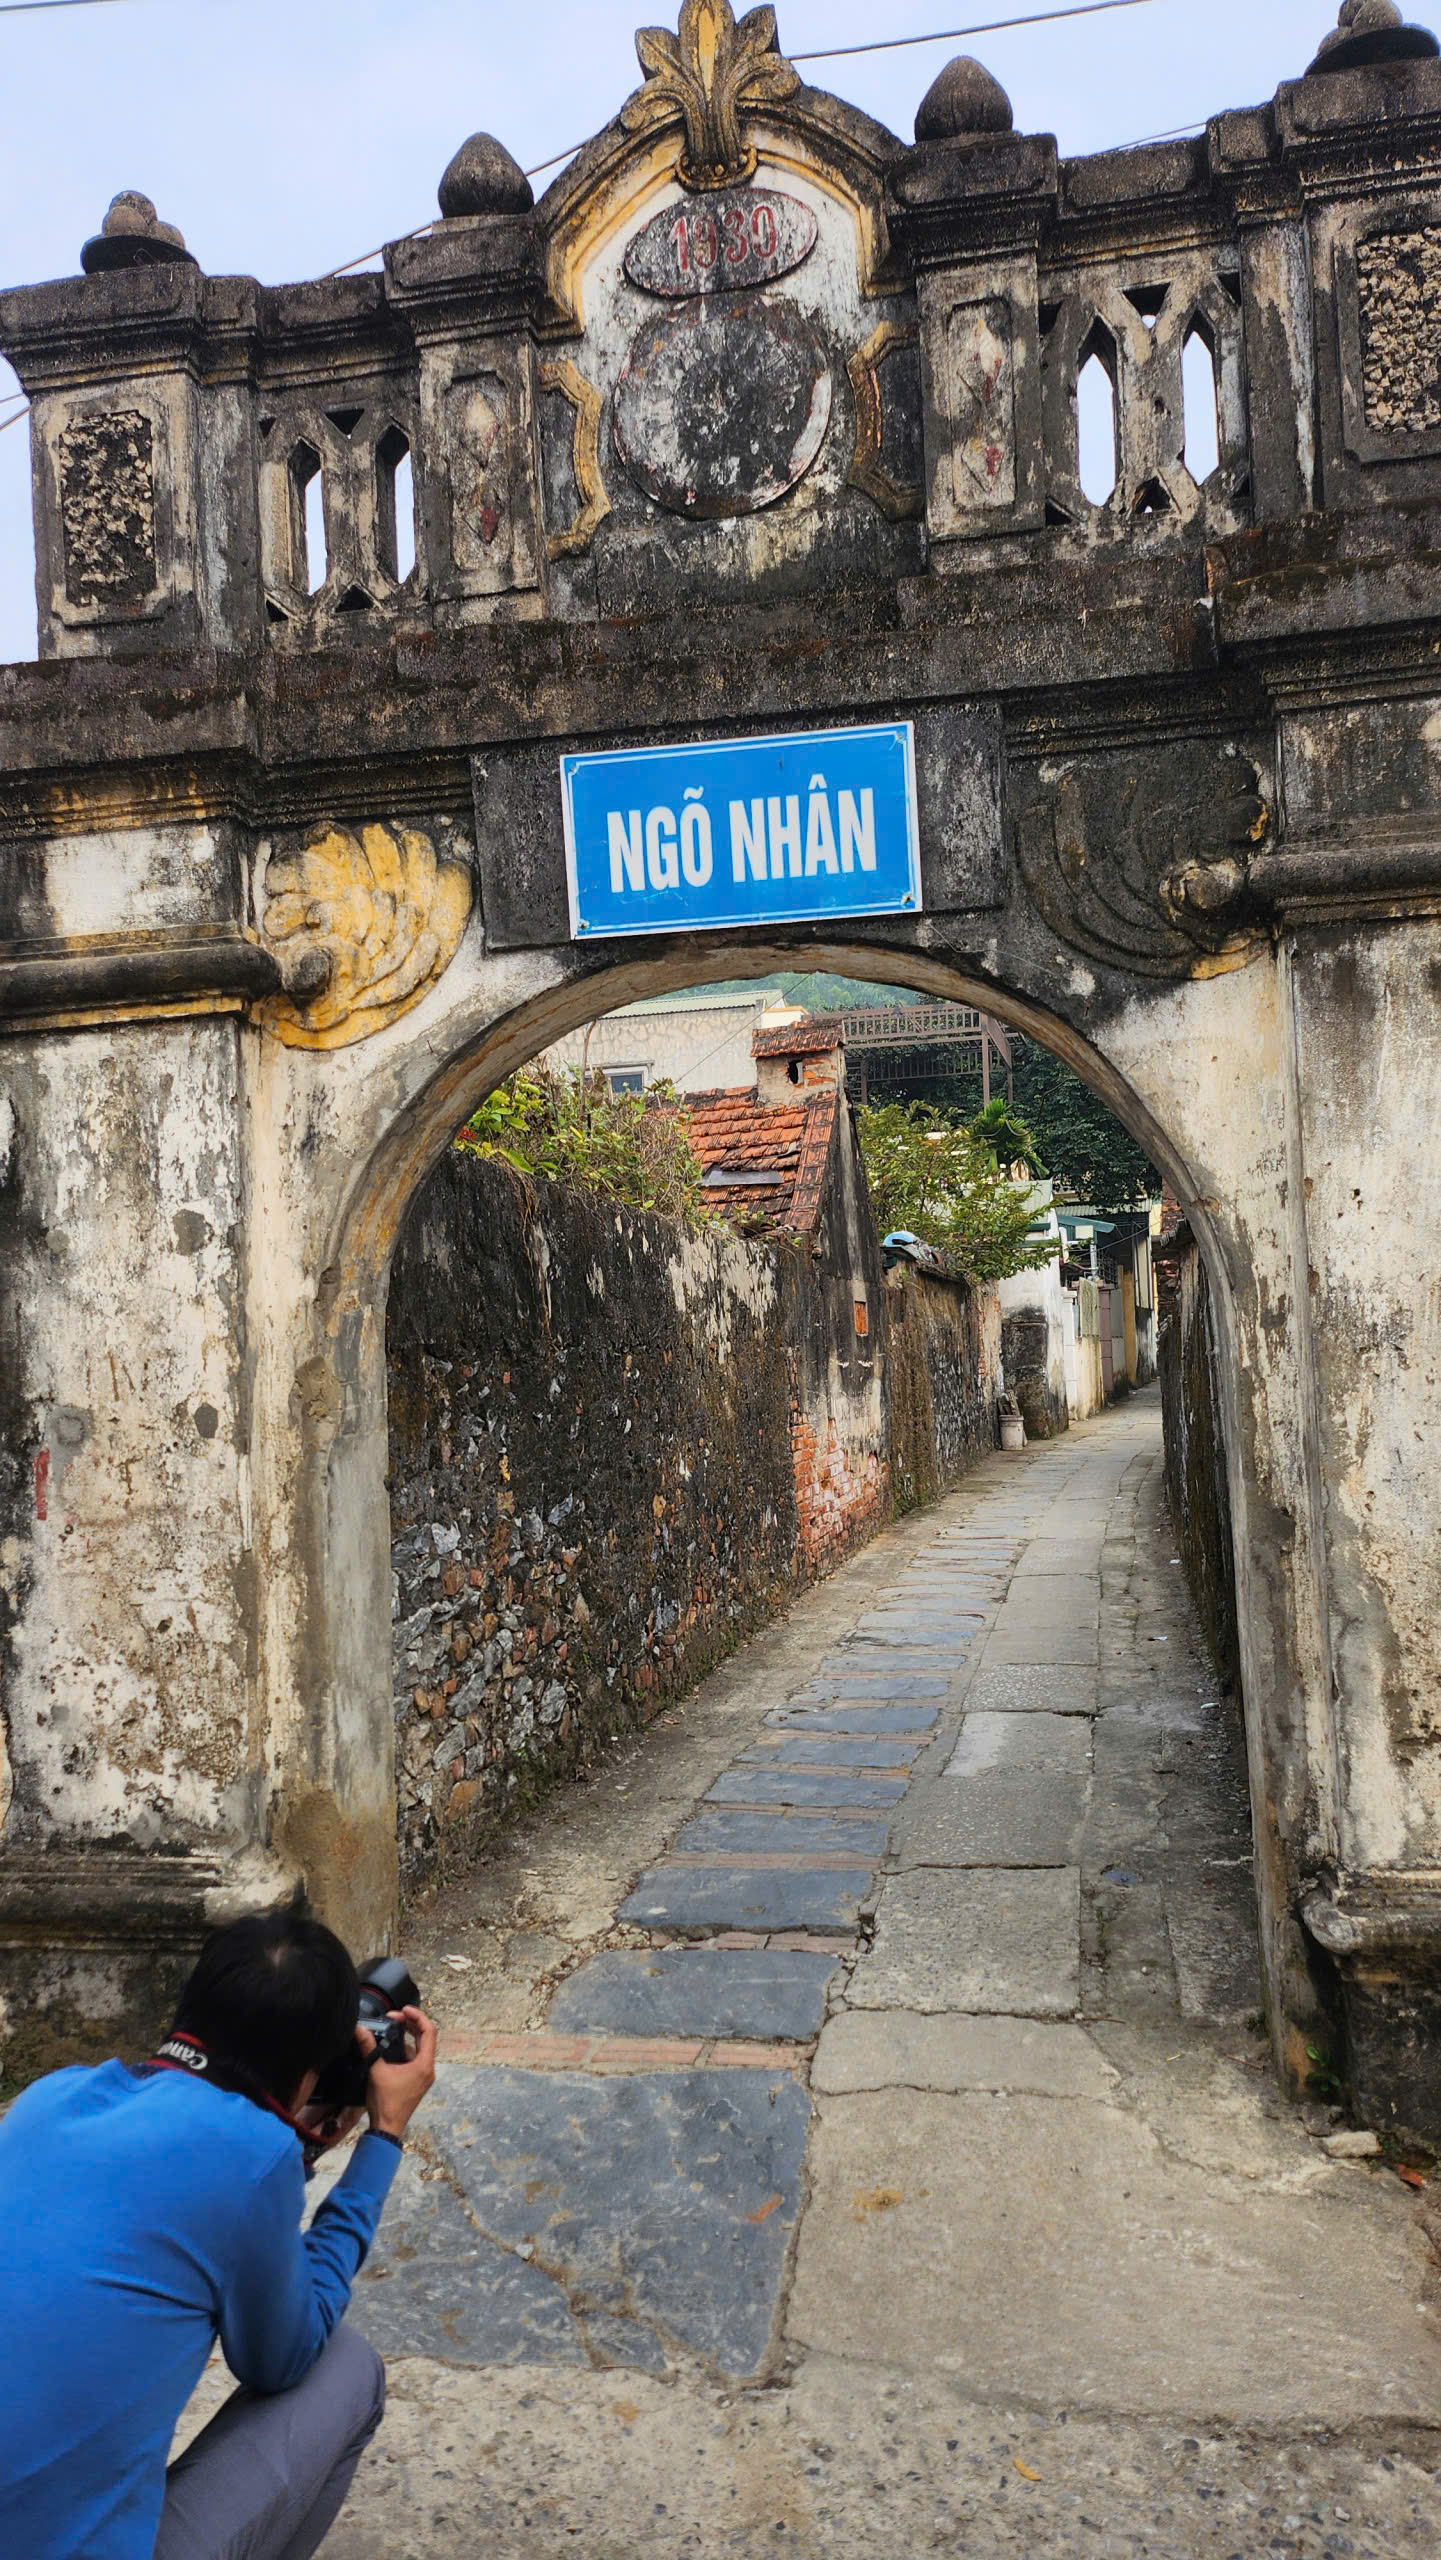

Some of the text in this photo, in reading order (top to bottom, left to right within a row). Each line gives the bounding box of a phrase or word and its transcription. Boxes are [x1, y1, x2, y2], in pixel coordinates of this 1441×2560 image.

[669, 205, 777, 272] 1930
[607, 773, 877, 893] NGÕ NHÂN
